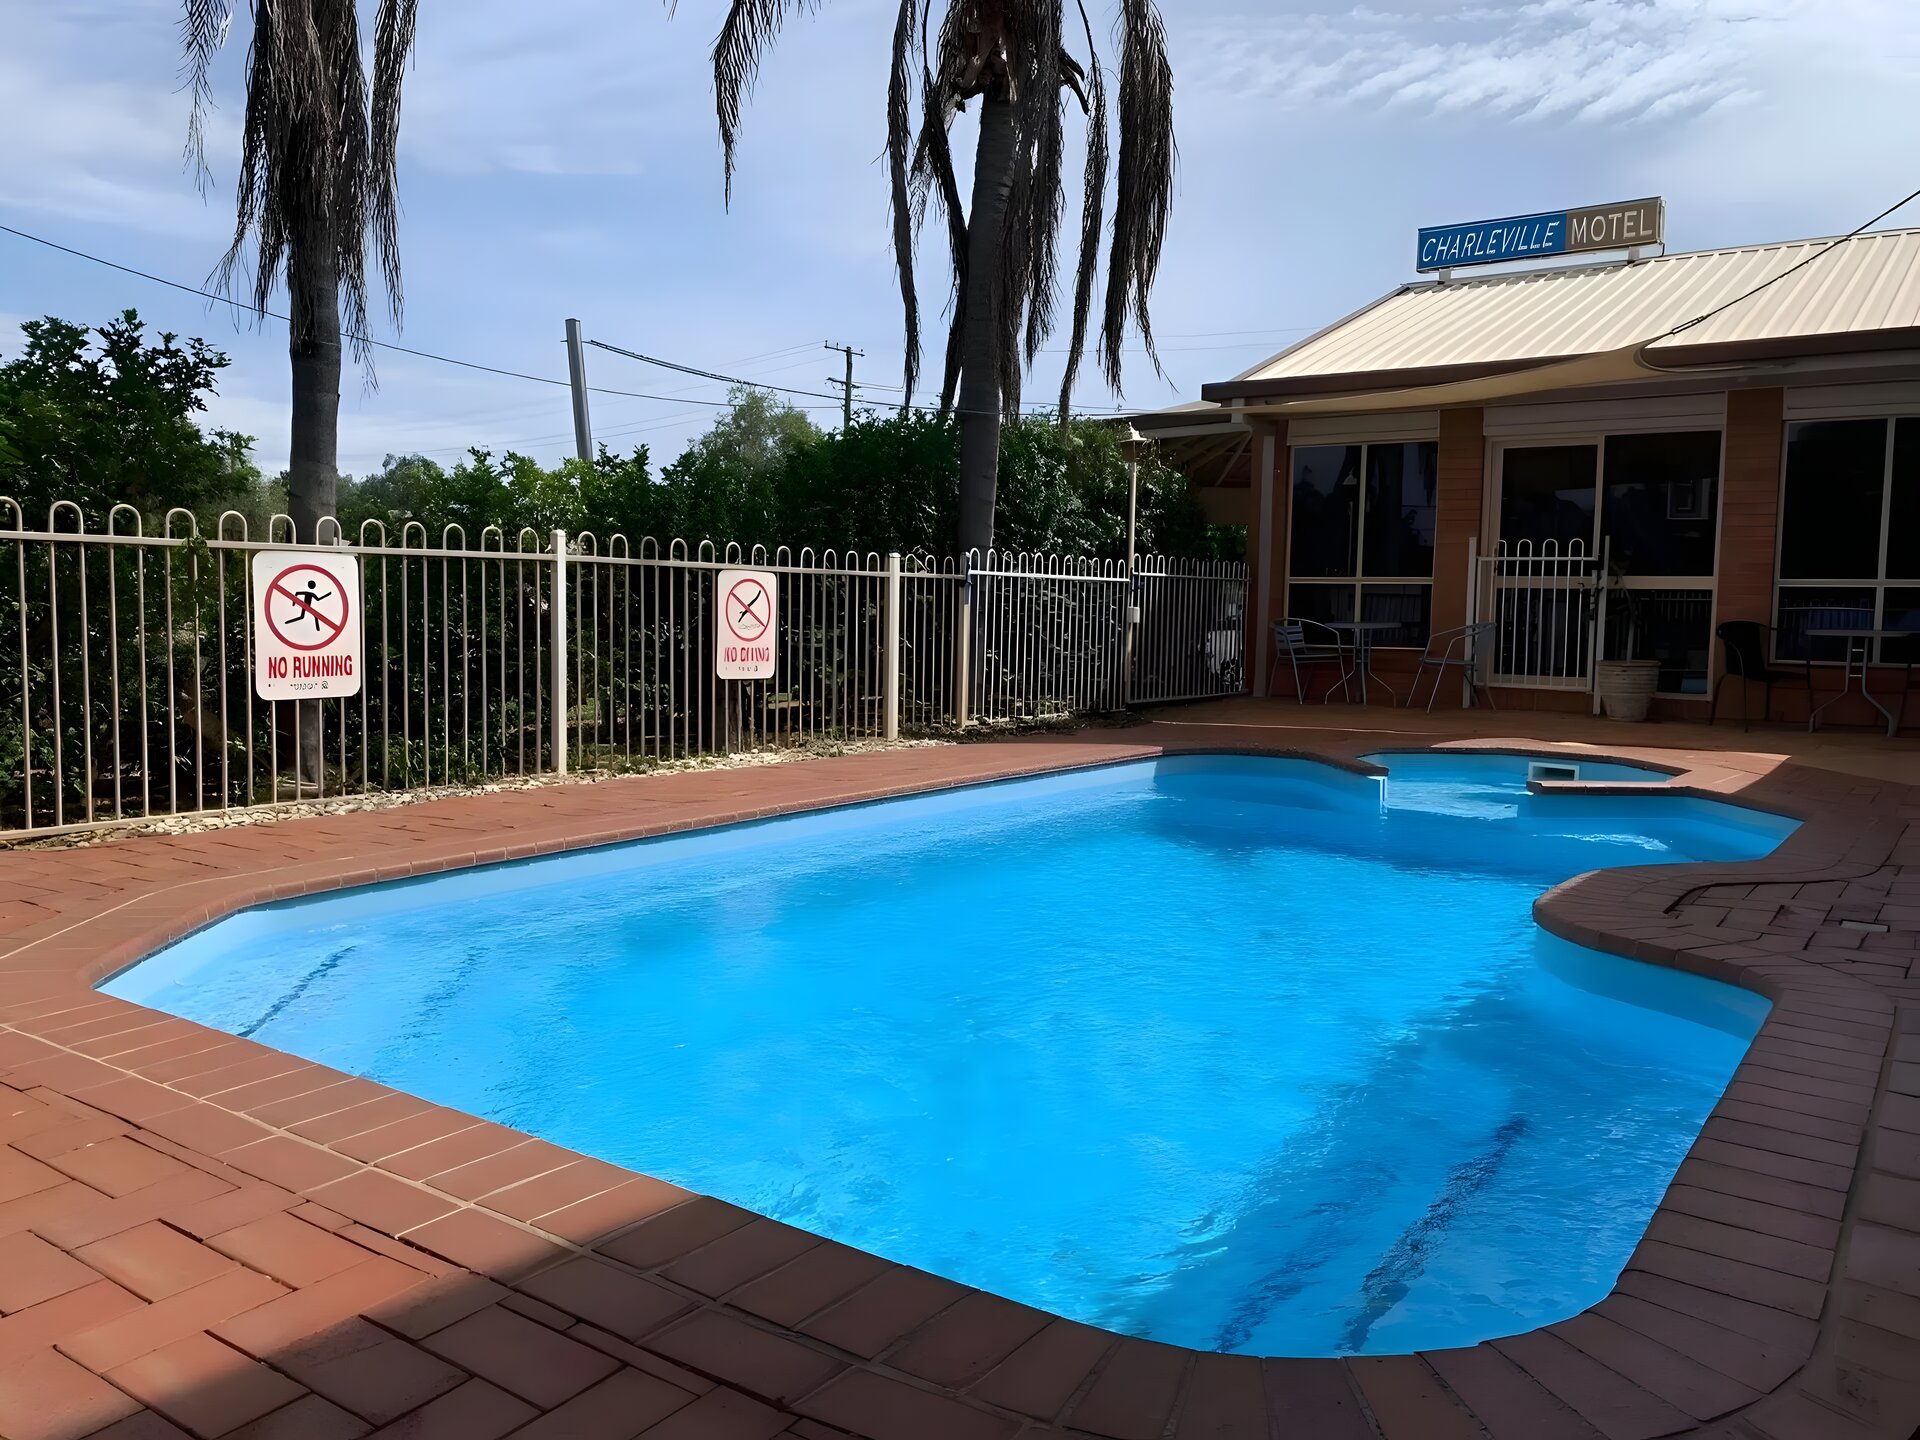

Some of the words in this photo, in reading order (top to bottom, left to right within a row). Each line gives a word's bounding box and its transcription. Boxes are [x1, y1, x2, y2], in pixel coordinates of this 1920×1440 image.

[1422, 221, 1560, 262] CHARLEVILLE
[1571, 209, 1653, 245] MOTEL
[268, 656, 288, 679] NO
[293, 655, 353, 678] RUNNING
